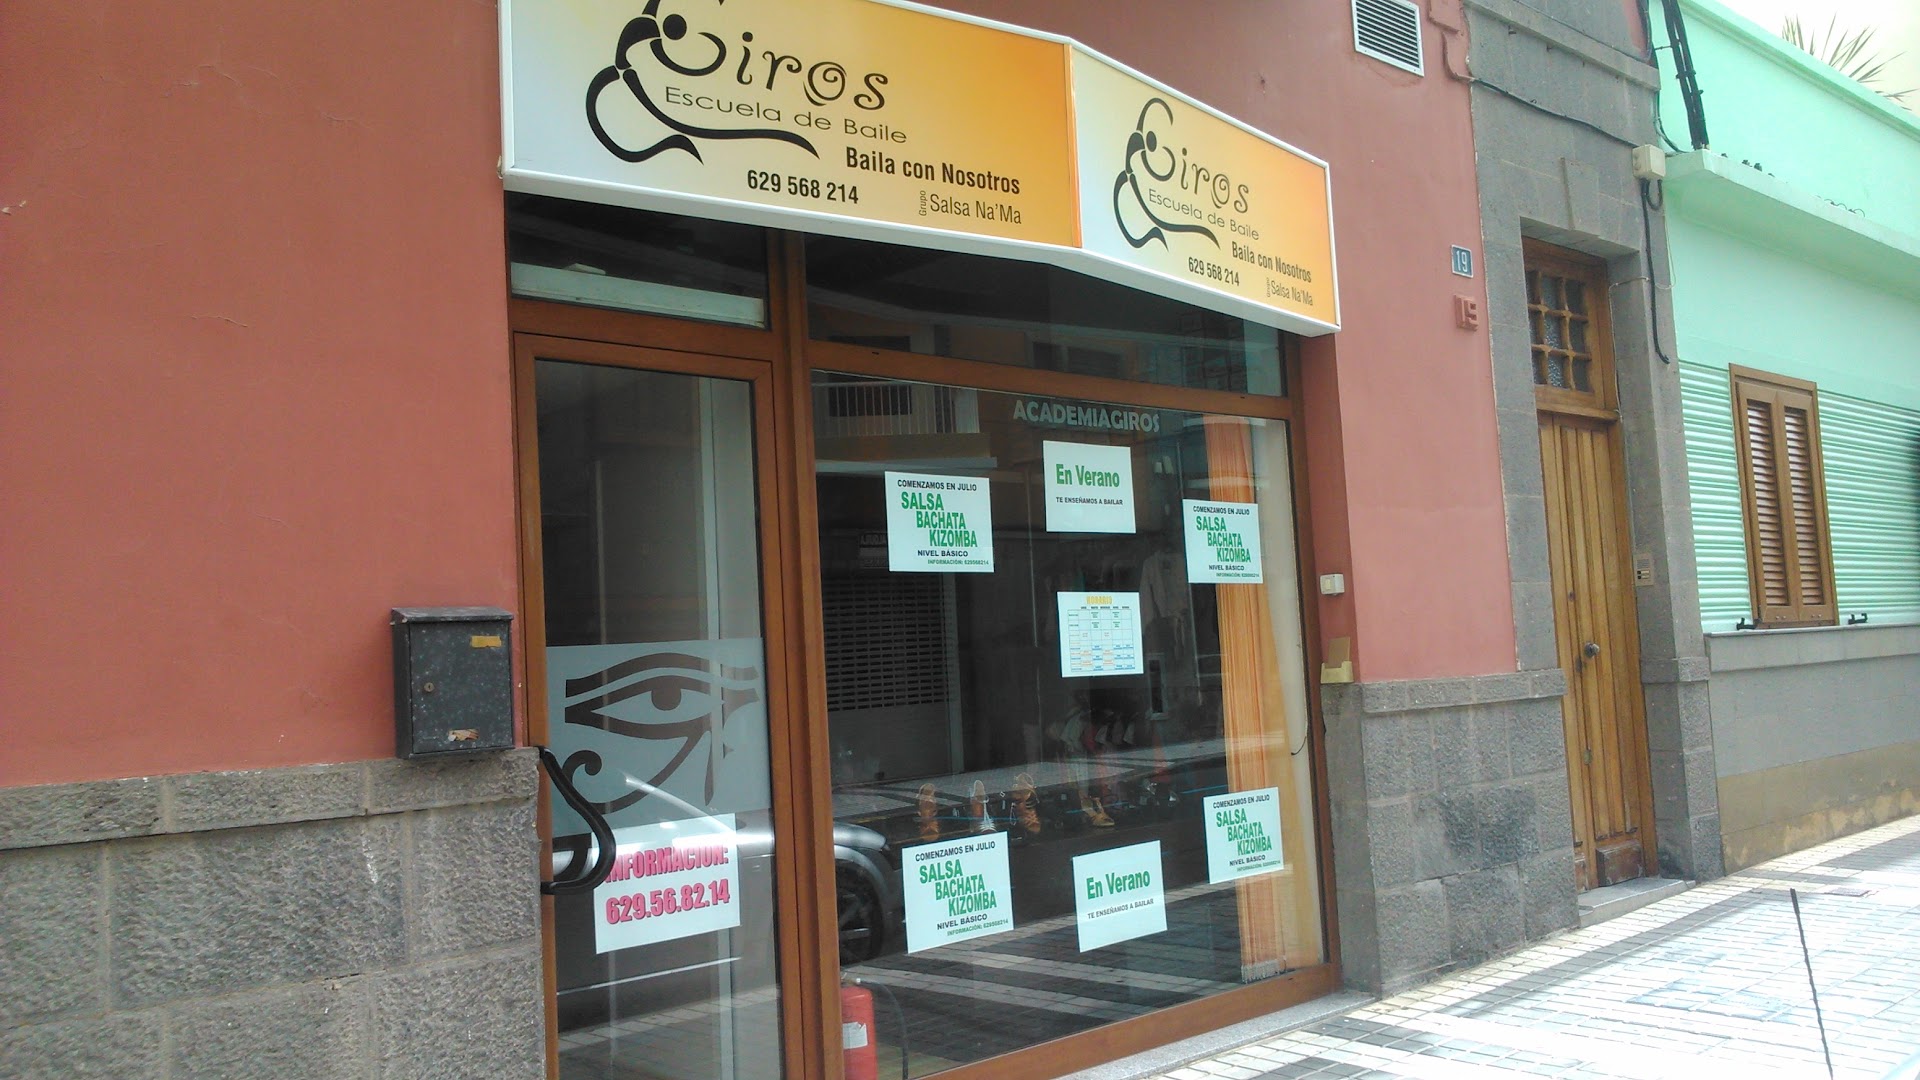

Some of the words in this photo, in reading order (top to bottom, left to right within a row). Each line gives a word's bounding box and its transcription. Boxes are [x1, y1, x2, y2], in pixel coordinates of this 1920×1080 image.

[665, 86, 782, 122] Escuela
[793, 111, 832, 130] de
[844, 118, 907, 145] Baile
[846, 146, 896, 175] Baila
[902, 160, 935, 181] con
[941, 162, 1021, 195] Nosotros
[747, 169, 782, 193] 629
[787, 175, 821, 199] 568
[826, 181, 859, 204] 214
[918, 190, 927, 217] Grupo
[929, 193, 971, 217] Salsa
[1148, 188, 1203, 220] Escuela
[1207, 212, 1225, 228] de
[1229, 219, 1260, 241] Baile
[1188, 256, 1205, 276] 629
[1206, 262, 1223, 281] 568
[1224, 268, 1240, 287] 214
[1231, 240, 1255, 264] Baila
[1257, 253, 1273, 271] con
[1274, 255, 1312, 283] Nosotros
[1455, 250, 1469, 273] 19
[1270, 280, 1291, 299] Salsa
[1013, 399, 1160, 433] ACADEMIAGIROS
[897, 479, 945, 490] COMENZAMOS
[946, 482, 956, 491] EN
[957, 483, 977, 492] JULIO
[1055, 463, 1073, 485] En
[1075, 465, 1120, 488] Verano
[901, 491, 944, 511] SALSA
[1055, 496, 1064, 504] TE
[1064, 496, 1098, 505] ENSEÑAMOS
[1103, 498, 1124, 506] BAILAR
[1193, 505, 1227, 514] COMENZAMOS
[1227, 507, 1235, 515] EN
[1235, 508, 1250, 516] JULIO
[916, 510, 967, 530] BACHATA
[1196, 515, 1227, 532] SALSA
[929, 529, 978, 548] KIZOMBA
[1207, 531, 1243, 548] BACHATA
[917, 549, 939, 557] NIVEL
[941, 548, 969, 557] BÁSICO
[1216, 547, 1251, 563] KIZOMBA
[1225, 563, 1245, 571] BÁSICO
[1213, 795, 1247, 809] COMENZAMOS
[1247, 795, 1255, 804] EN
[1255, 793, 1270, 802] JULIO
[1216, 808, 1248, 828] SALSA
[1227, 821, 1264, 842] BACHATA
[915, 845, 963, 862] COMENZAMOS
[964, 844, 974, 854] EN
[975, 840, 996, 852] JULIO
[1237, 836, 1272, 856] KIZOMBA
[919, 858, 963, 884] SALSA
[1229, 858, 1245, 867] NIVEL
[1246, 854, 1266, 863] BÁSICO
[935, 873, 986, 901] BACHATA
[1086, 877, 1104, 900] En
[1105, 870, 1151, 895] Verano
[605, 878, 731, 925] 629.56.82.14
[948, 890, 998, 917] KIZOMBA
[1087, 912, 1096, 920] TE
[1095, 903, 1129, 918] ENSEÑAMOS
[1134, 898, 1154, 907] BAILAR
[937, 920, 959, 931] NIVEL
[960, 913, 988, 925] BÁSICO
